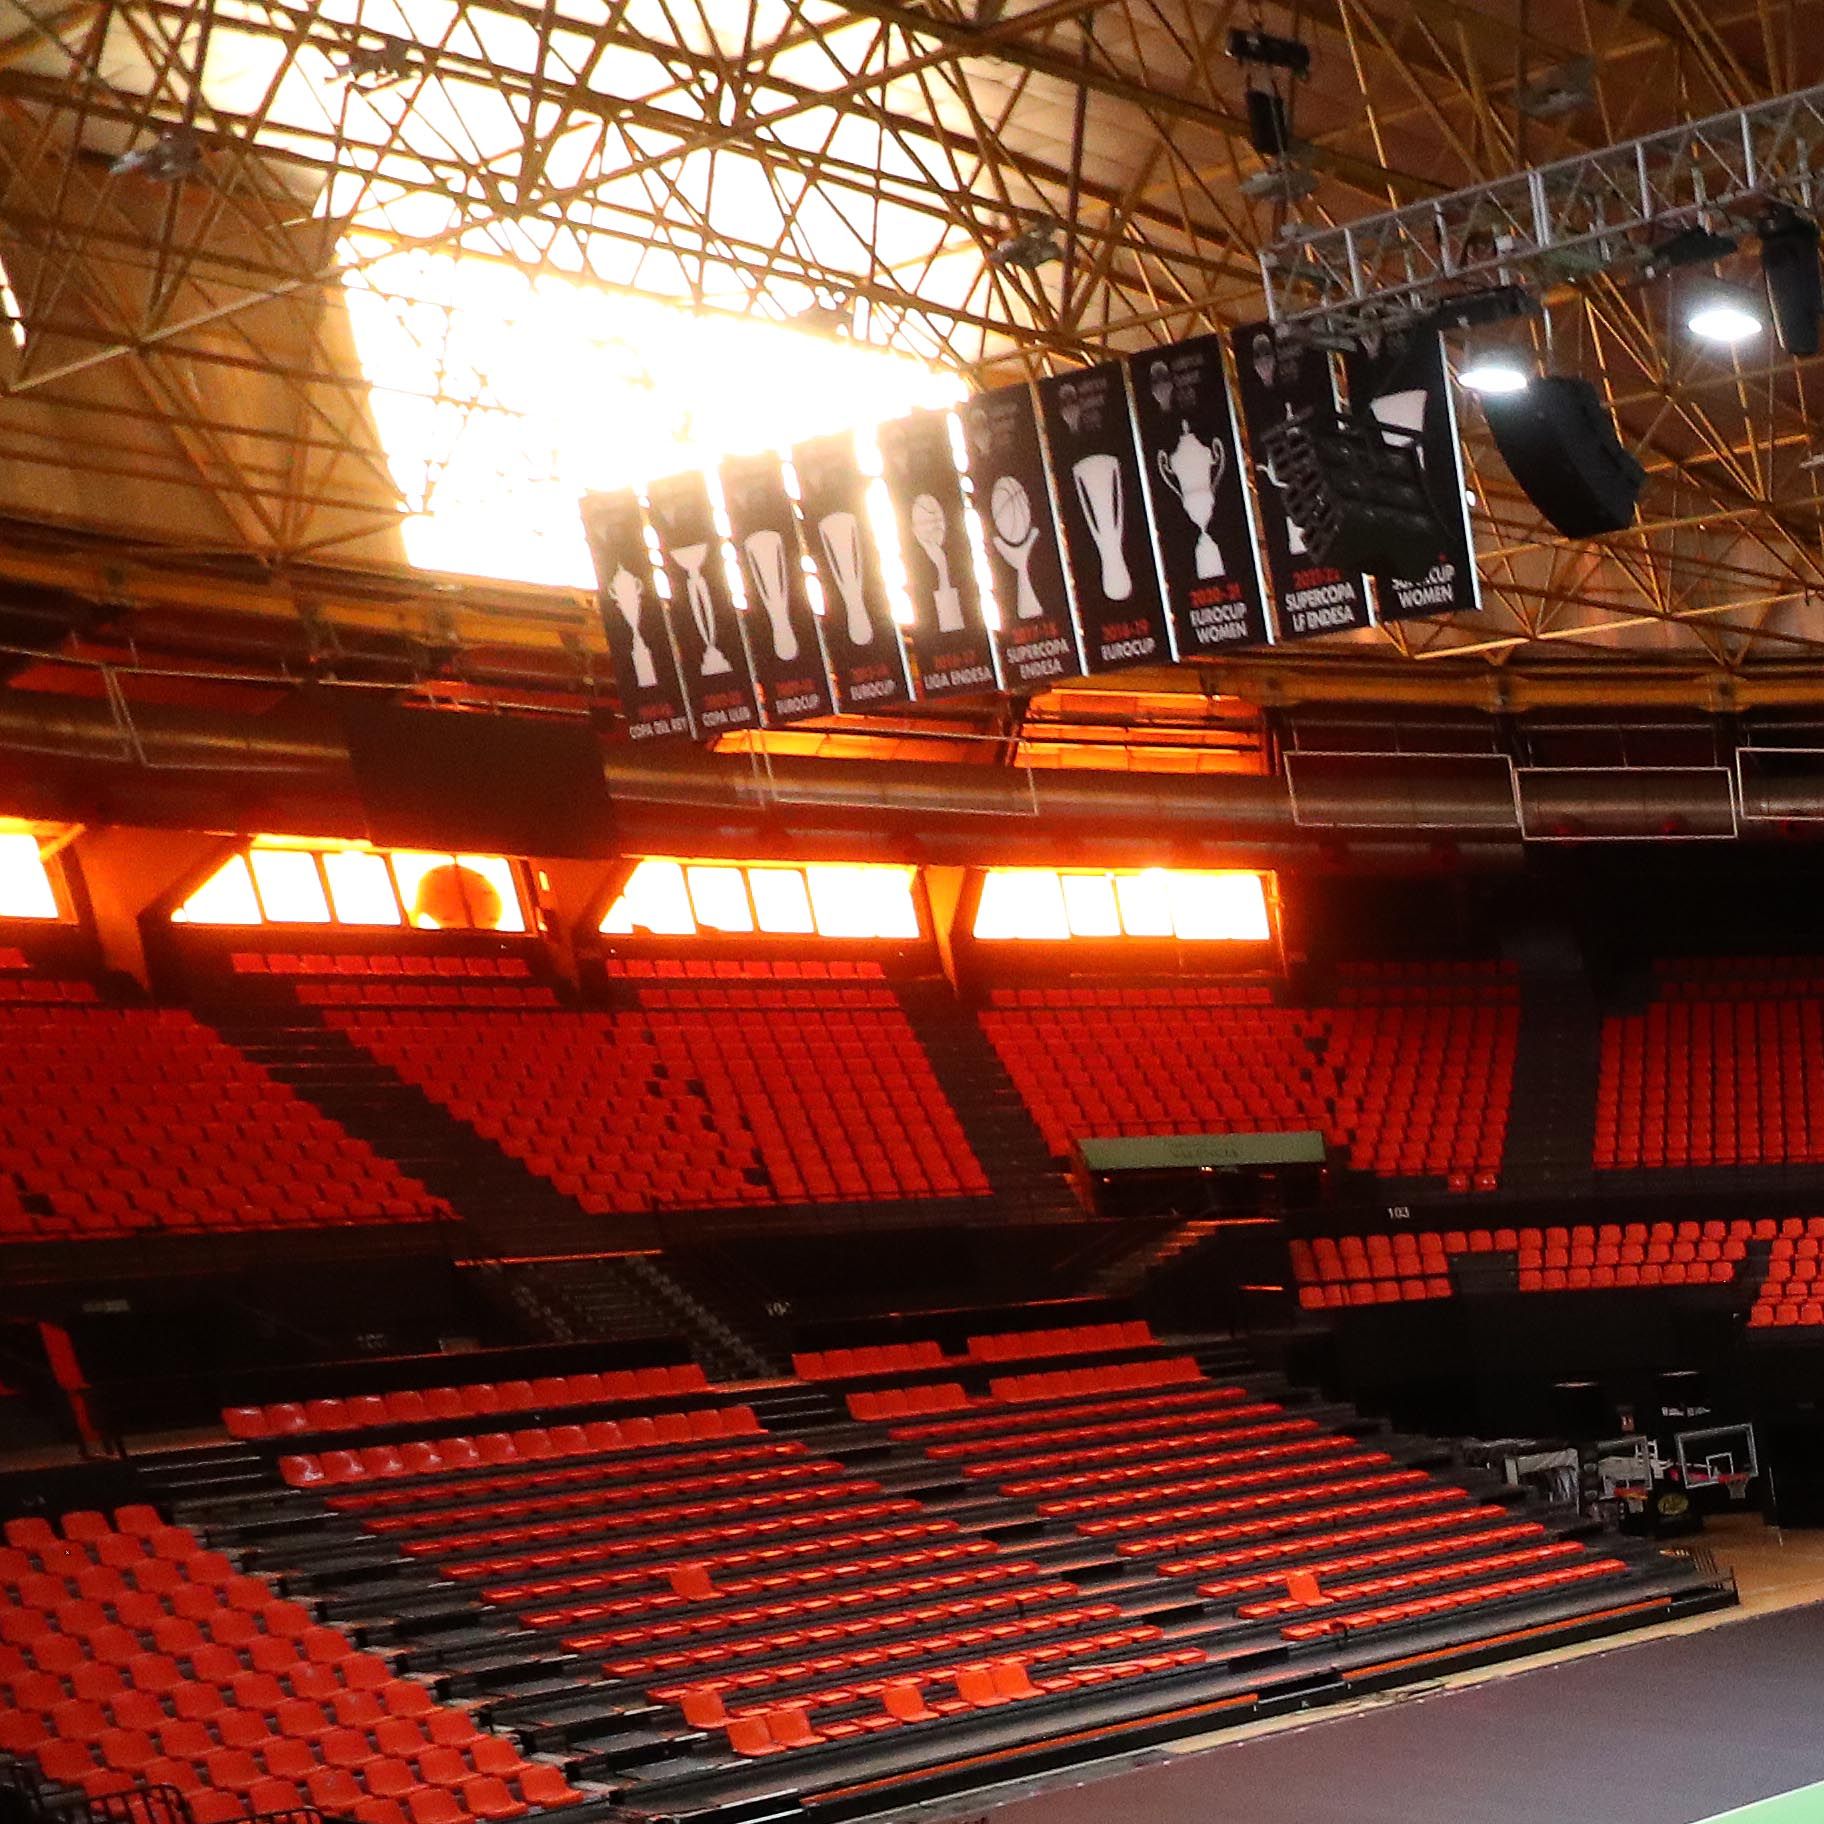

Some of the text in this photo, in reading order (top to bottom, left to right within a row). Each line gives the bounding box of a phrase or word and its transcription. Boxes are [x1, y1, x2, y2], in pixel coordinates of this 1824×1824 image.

[1285, 581, 1355, 612] SUPERCOPA
[1399, 583, 1454, 609] WOMEN
[1189, 602, 1247, 628] EUROCUP
[1292, 605, 1354, 632] LF ENDESA
[1196, 621, 1248, 644] WOMEN
[1006, 638, 1070, 664] SUPERCOPA
[1101, 637, 1155, 661] EUROCUP
[923, 666, 993, 690] LIGA ENDESA
[1019, 658, 1063, 681] ENDESA
[1387, 1206, 1410, 1219] 103
